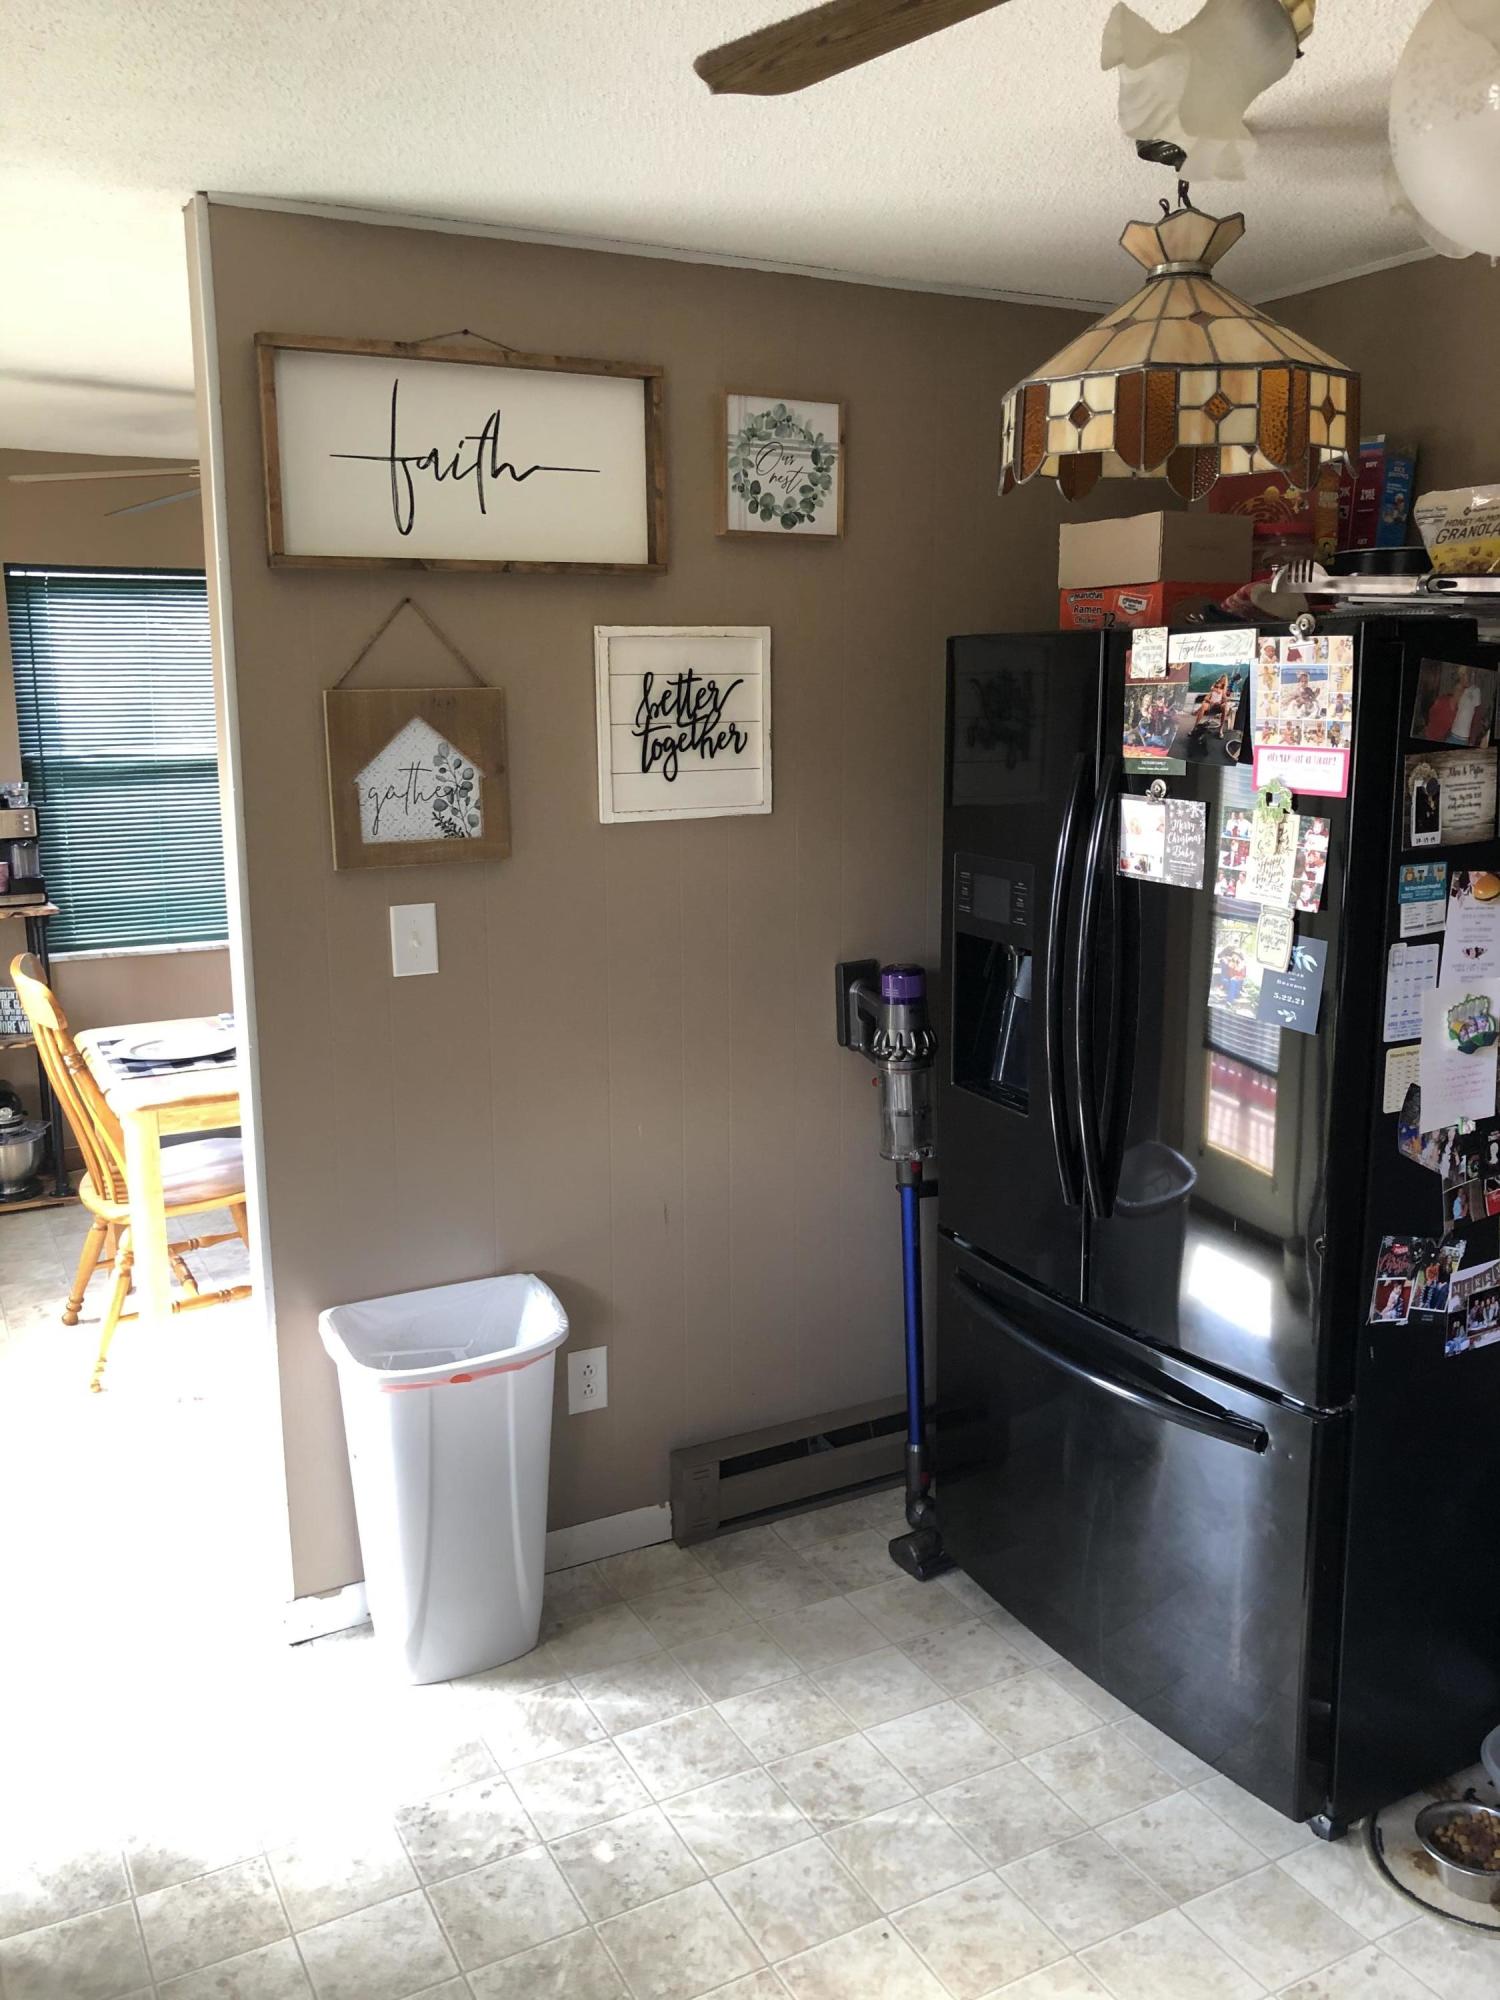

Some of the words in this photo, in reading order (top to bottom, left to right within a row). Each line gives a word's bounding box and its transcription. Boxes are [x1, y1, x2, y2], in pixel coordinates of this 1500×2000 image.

[330, 378, 600, 535] faith
[754, 440, 796, 476] Our
[768, 468, 806, 493] nest
[1435, 522, 1500, 545] GRANOLA
[1445, 519, 1473, 527] HONEY
[1072, 604, 1102, 614] Ramen
[1102, 612, 1116, 629] 12
[637, 668, 744, 727] better
[632, 714, 748, 782] together
[367, 761, 464, 836] gather
